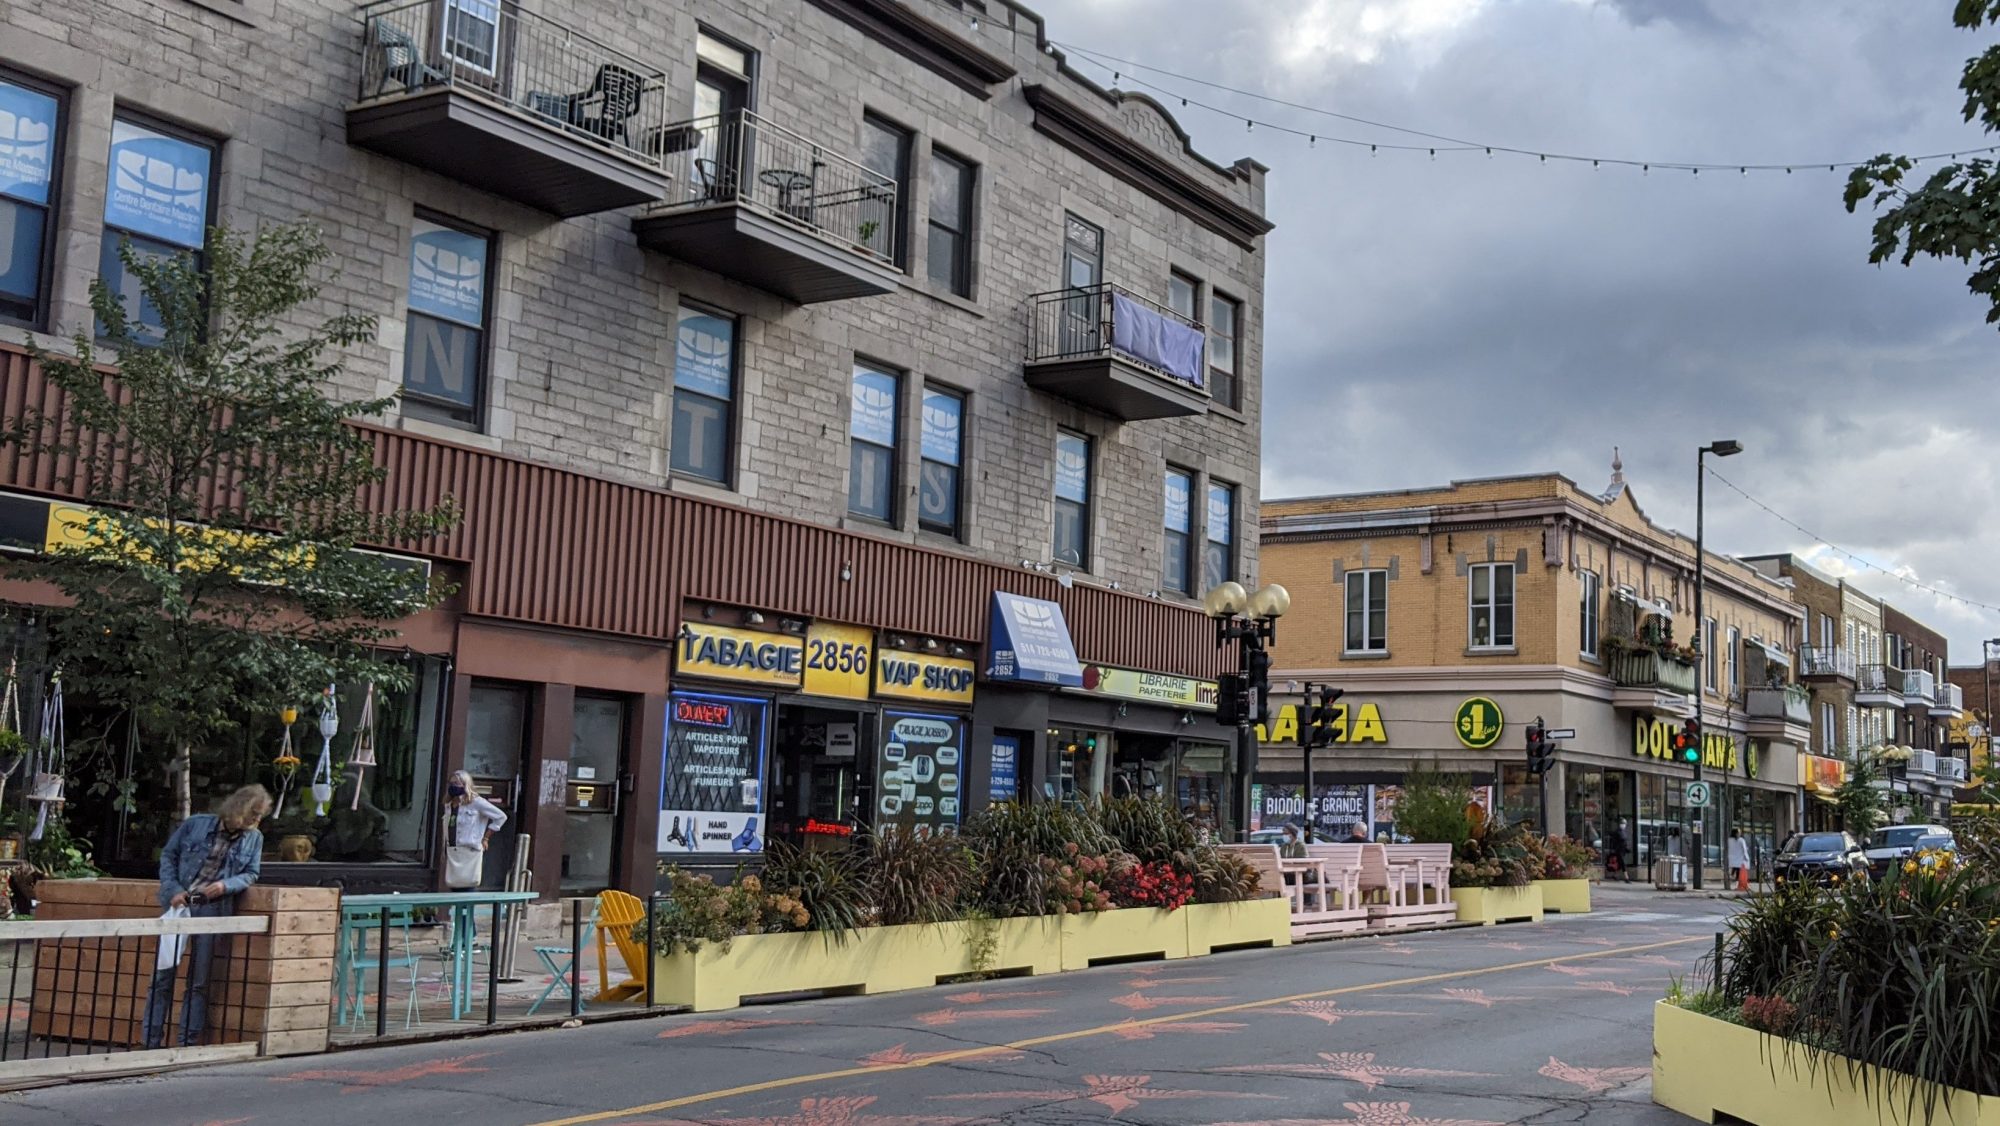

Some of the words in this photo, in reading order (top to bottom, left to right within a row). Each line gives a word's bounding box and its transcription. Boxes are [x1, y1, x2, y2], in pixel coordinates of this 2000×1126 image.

[681, 625, 803, 674] TABAGIE
[807, 639, 868, 675] 2856
[881, 658, 920, 686] VAP
[923, 664, 974, 693] SHOP
[995, 664, 1014, 676] 2852
[1138, 672, 1188, 690] LIBRAIRIE
[1138, 686, 1188, 700] PAPETERIE
[685, 732, 723, 743] ARTICLES
[726, 735, 748, 745] POUR
[693, 744, 740, 755] VAPOTEURS
[683, 764, 723, 774] ARTICLES
[725, 767, 747, 776] POUR
[694, 777, 734, 787] FUMEURS
[1322, 798, 1363, 813] GRANDE
[708, 820, 728, 829] HAND
[1322, 813, 1363, 825] RÉOUVERTURE
[702, 832, 733, 841] SPINNER
